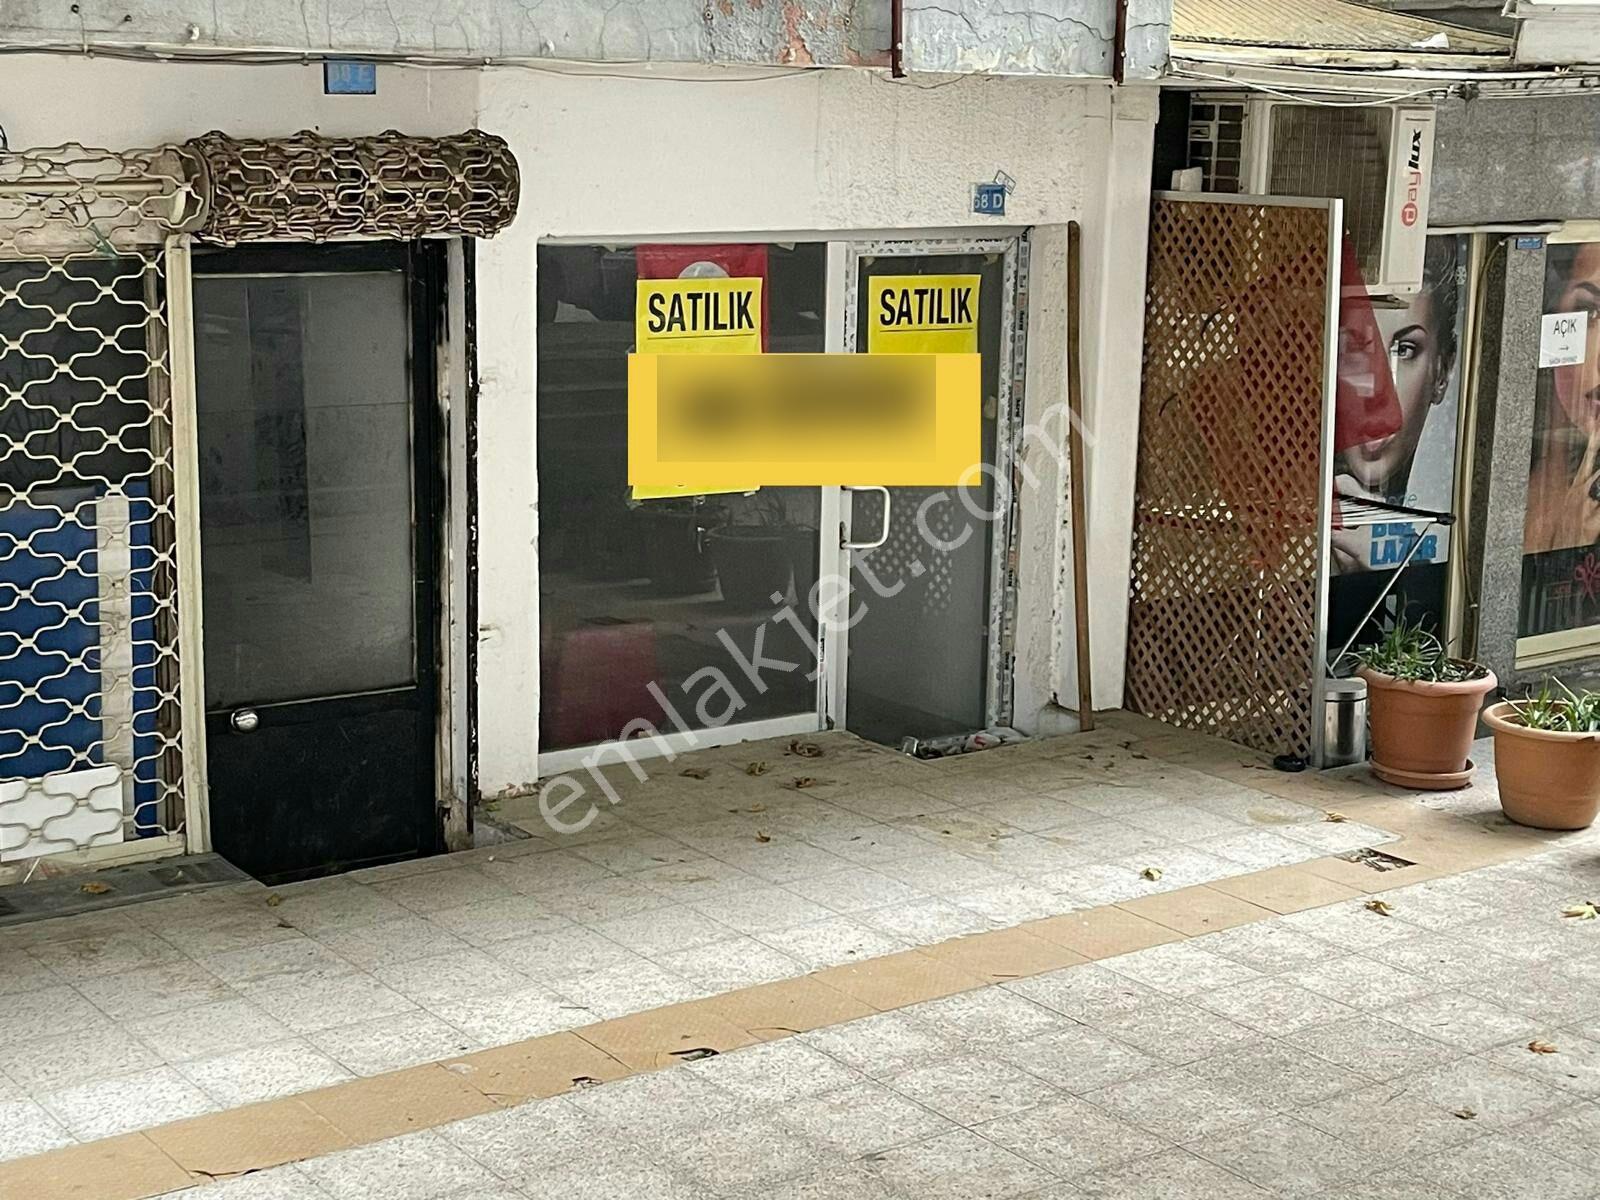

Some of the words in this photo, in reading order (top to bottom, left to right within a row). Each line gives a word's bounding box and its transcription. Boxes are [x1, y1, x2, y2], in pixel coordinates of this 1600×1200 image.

[993, 193, 1003, 208] D
[648, 291, 754, 333] SATILIK
[880, 287, 973, 326] SATILIK
[1553, 319, 1577, 337] AÇIK
